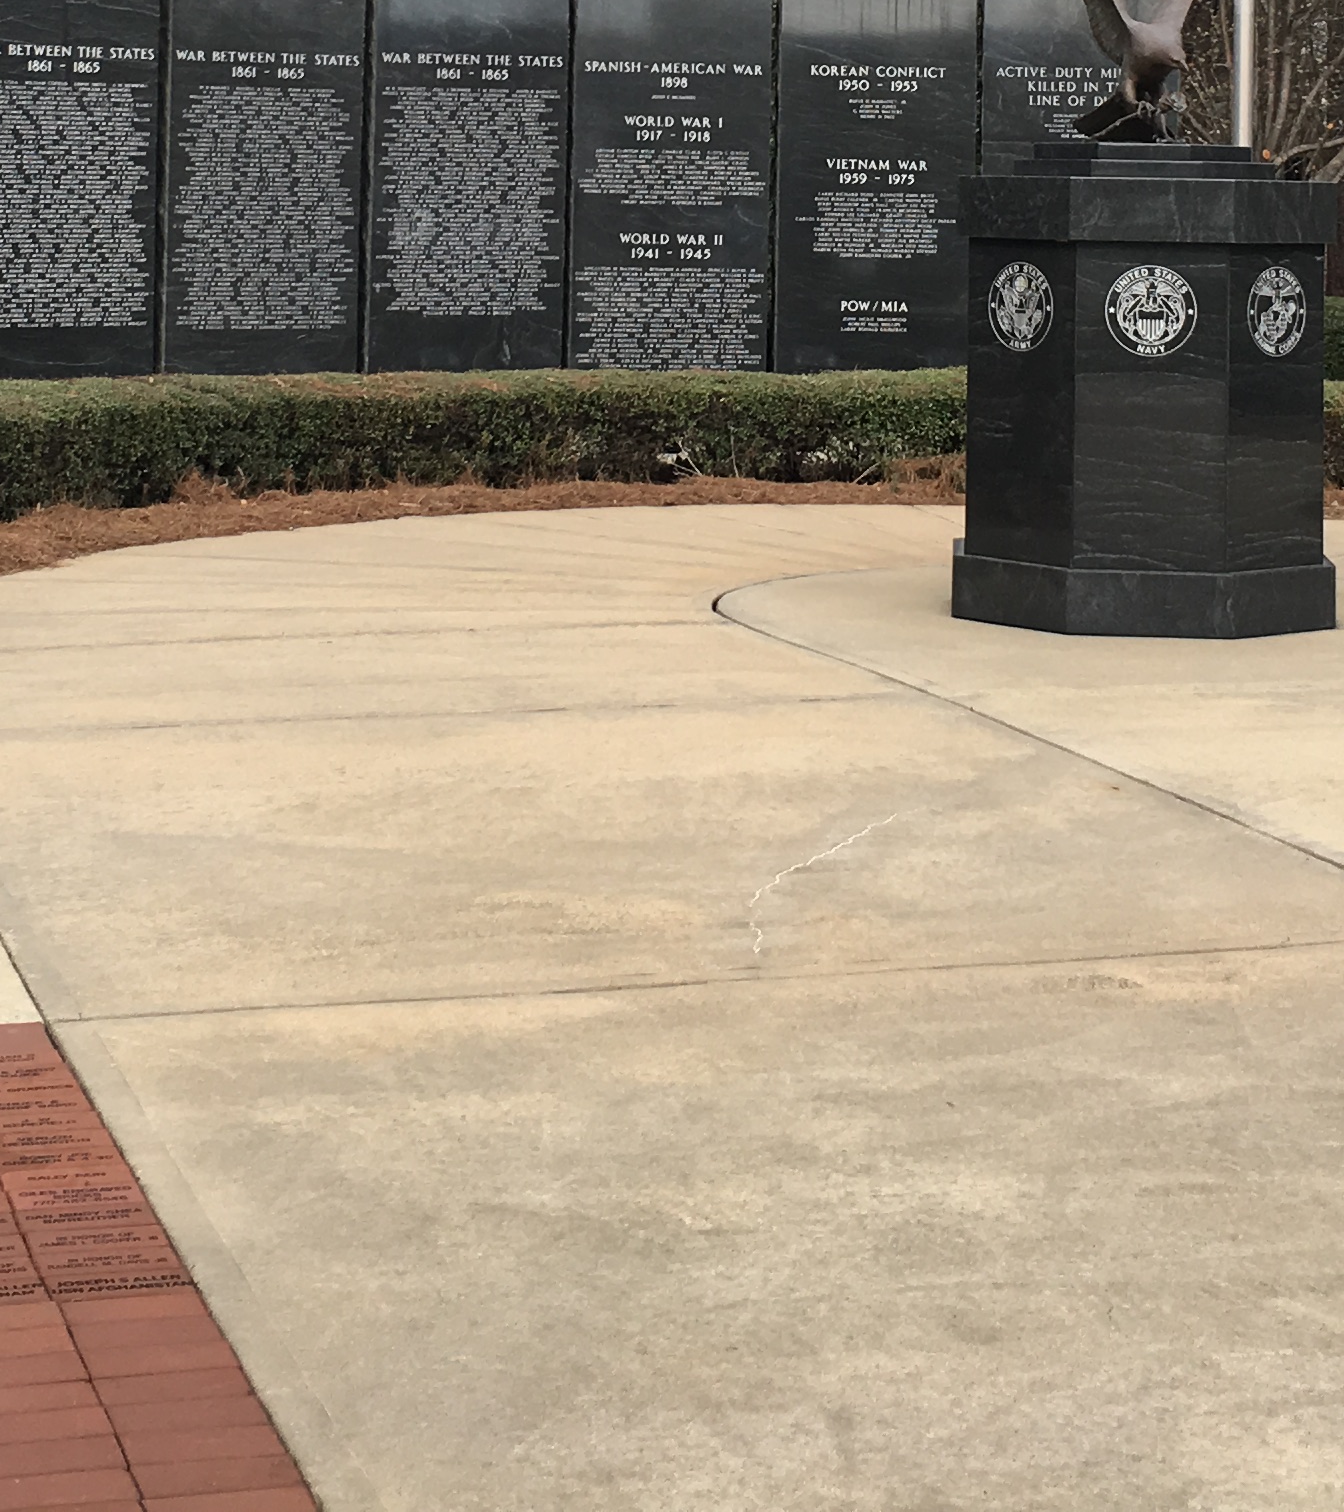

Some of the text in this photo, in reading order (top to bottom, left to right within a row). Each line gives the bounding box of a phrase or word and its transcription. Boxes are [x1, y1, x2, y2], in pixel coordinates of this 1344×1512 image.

[8, 44, 72, 57] BETWEEN
[77, 46, 104, 58] THE
[109, 47, 155, 61] STATES
[176, 49, 360, 67] WAR BETWEEN THE STATES
[27, 59, 52, 72] 1861
[73, 61, 100, 74] 1865
[381, 52, 563, 68] WAR BETWEEN THE STATES
[231, 66, 256, 78] 1861
[277, 67, 305, 79] 1865
[436, 68, 461, 79] 1861
[481, 68, 509, 81] 1865
[733, 64, 763, 76] WAR
[810, 64, 946, 78] KOREAN CONFLICT
[996, 66, 1047, 78] ACTIVE
[1055, 67, 1093, 78] DUTY
[660, 77, 688, 89] 1898
[838, 79, 870, 91] 1950
[890, 80, 918, 92] 1953
[1027, 81, 1076, 92] KILLED
[1083, 81, 1098, 92] IN
[1029, 95, 1060, 106] LINE
[1067, 95, 1087, 106] OF
[624, 115, 723, 128] WORLD WAR I
[636, 130, 662, 141] 1917
[683, 131, 711, 143] 1918
[826, 158, 928, 171] VIETNAM WAR
[839, 173, 867, 184] 1959
[888, 173, 915, 185] 1975
[619, 232, 723, 245] WORLD WAR II
[631, 247, 659, 259] 1941
[680, 248, 712, 260] 1945
[994, 265, 1048, 289] UNITED STATES
[1114, 269, 1188, 294] UNITED STATES
[1009, 340, 1031, 349] ARMY
[1136, 345, 1165, 354] NAVY
